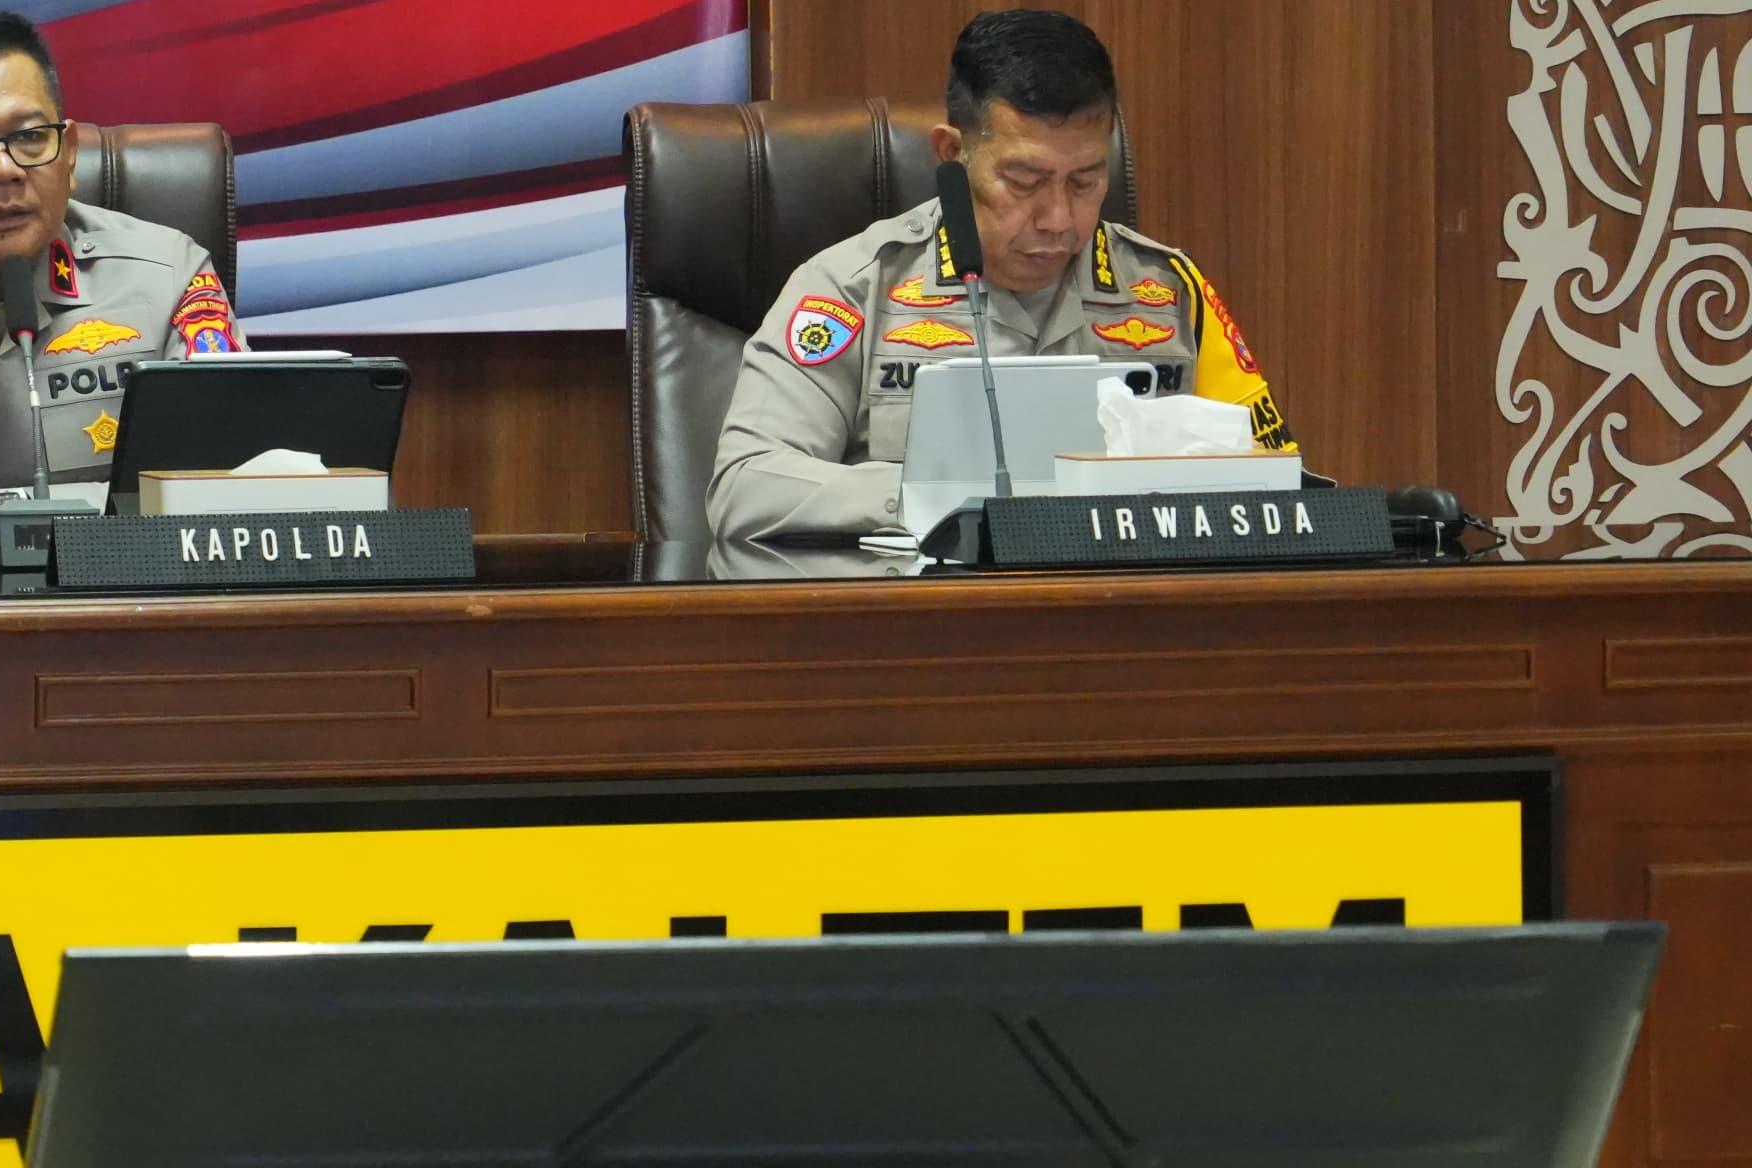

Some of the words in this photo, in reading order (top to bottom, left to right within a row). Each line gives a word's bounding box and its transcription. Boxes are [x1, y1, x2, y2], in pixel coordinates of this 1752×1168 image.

[803, 299, 859, 327] INSPEKTORAT
[1090, 502, 1314, 540] IRWASDA
[180, 524, 372, 562] KAPOLDA
